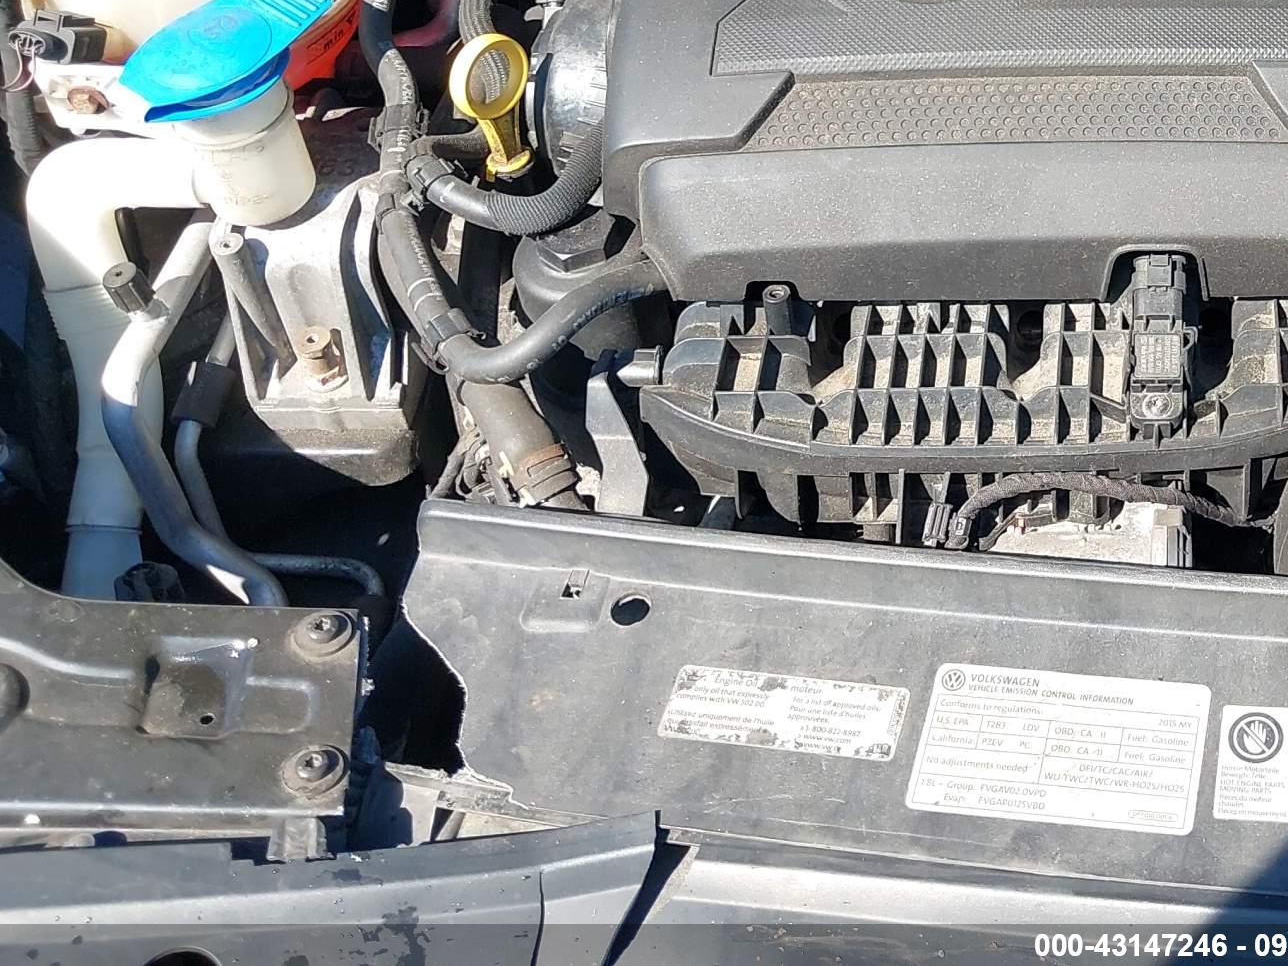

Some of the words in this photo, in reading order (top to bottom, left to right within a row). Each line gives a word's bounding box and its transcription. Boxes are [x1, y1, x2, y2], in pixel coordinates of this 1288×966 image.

[323, 28, 345, 52] min
[714, 675, 744, 687] Engine
[744, 679, 758, 687] Oil
[969, 672, 1040, 687] VOLKSWAGEN
[708, 695, 725, 703] with
[720, 688, 736, 696] that
[735, 690, 770, 701] expressly
[967, 683, 998, 693] VEHICLE
[1000, 686, 1038, 696] EMISSION
[1040, 689, 1076, 700] CONTROL
[1079, 692, 1134, 705] INFORMATION
[831, 700, 866, 712] approved
[939, 698, 982, 710] Conforms
[982, 702, 993, 711] to
[1022, 723, 1040, 732] LDV
[1079, 728, 1093, 737] CA
[1150, 735, 1190, 746] Gasoline
[1075, 746, 1090, 756] CA
[925, 755, 939, 763] No
[939, 756, 994, 771] adjustments
[995, 761, 1029, 773] needed
[1147, 752, 1187, 765] Gasoline
